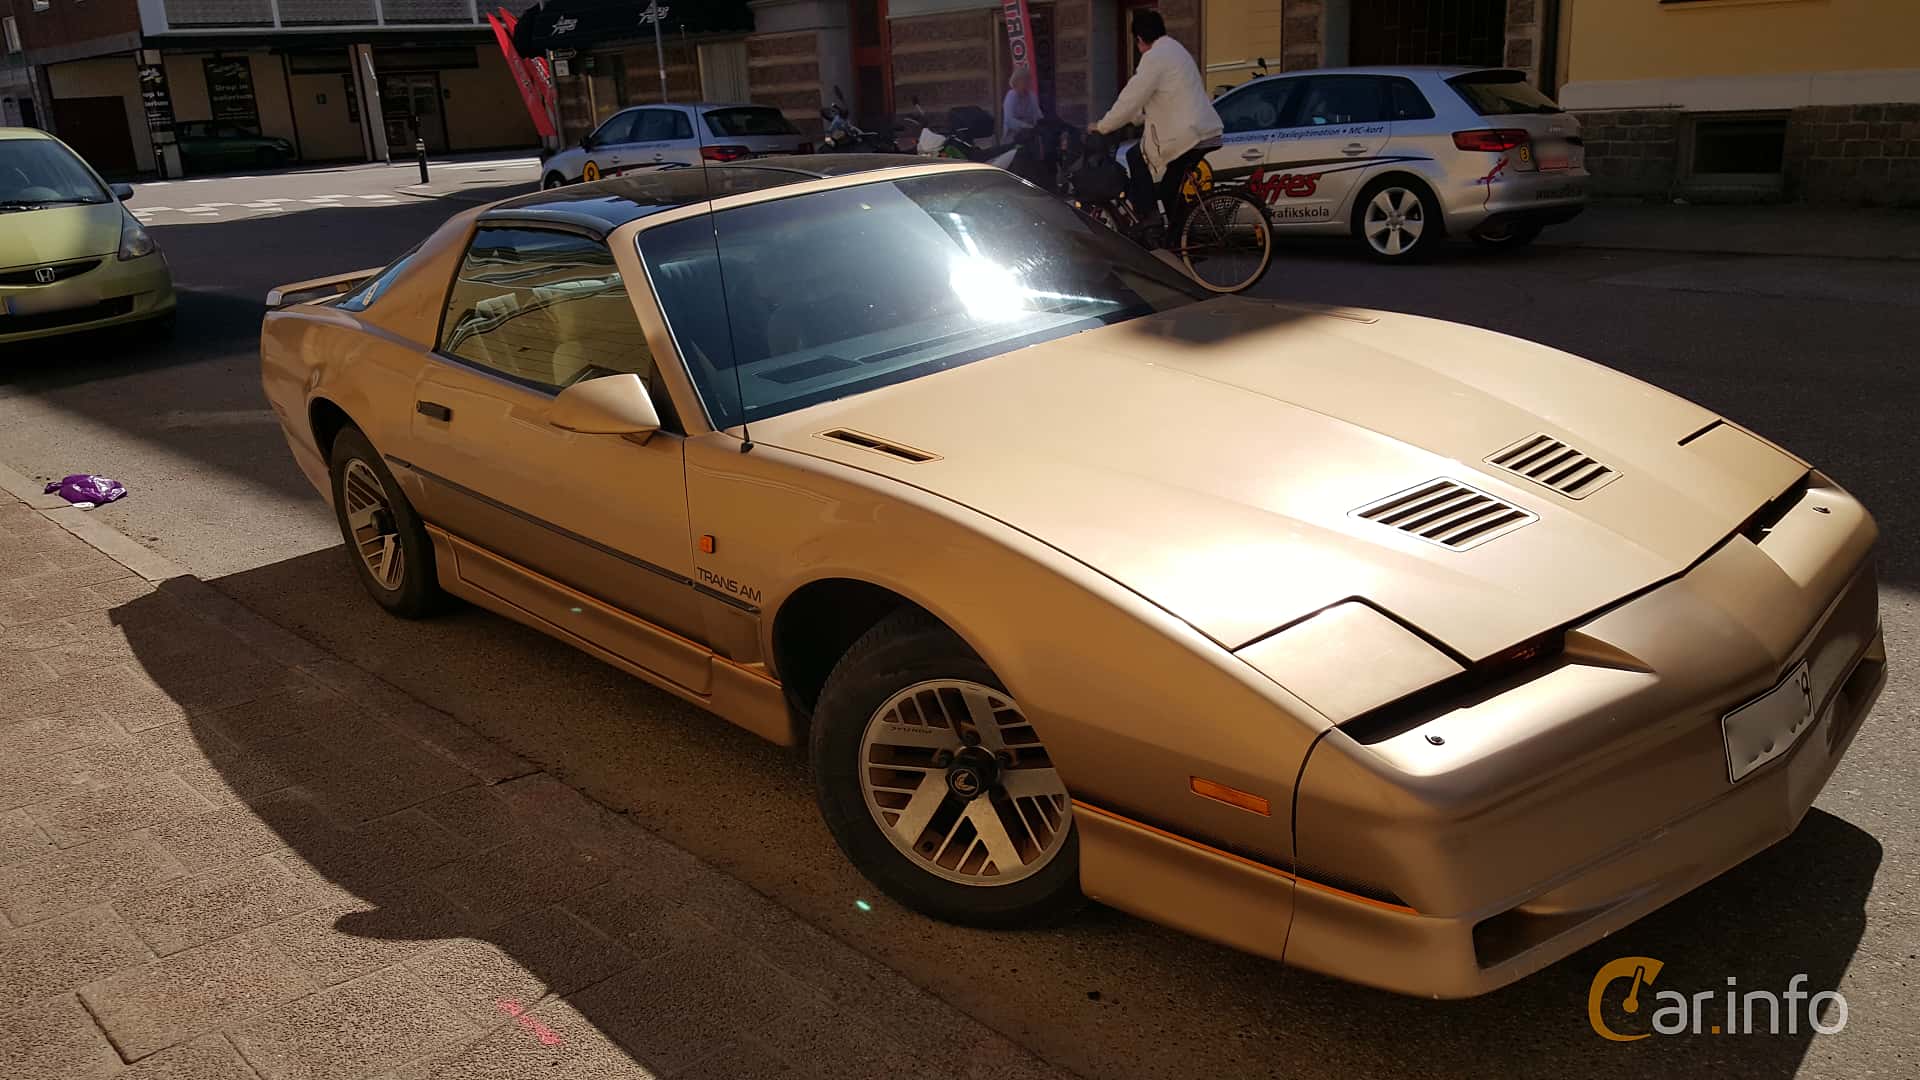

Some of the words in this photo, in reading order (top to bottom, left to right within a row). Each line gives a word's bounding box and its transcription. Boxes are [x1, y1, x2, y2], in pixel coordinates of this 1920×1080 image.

[1270, 205, 1330, 219] rafikskola
[697, 566, 738, 593] TRANS
[740, 584, 762, 603] AM
